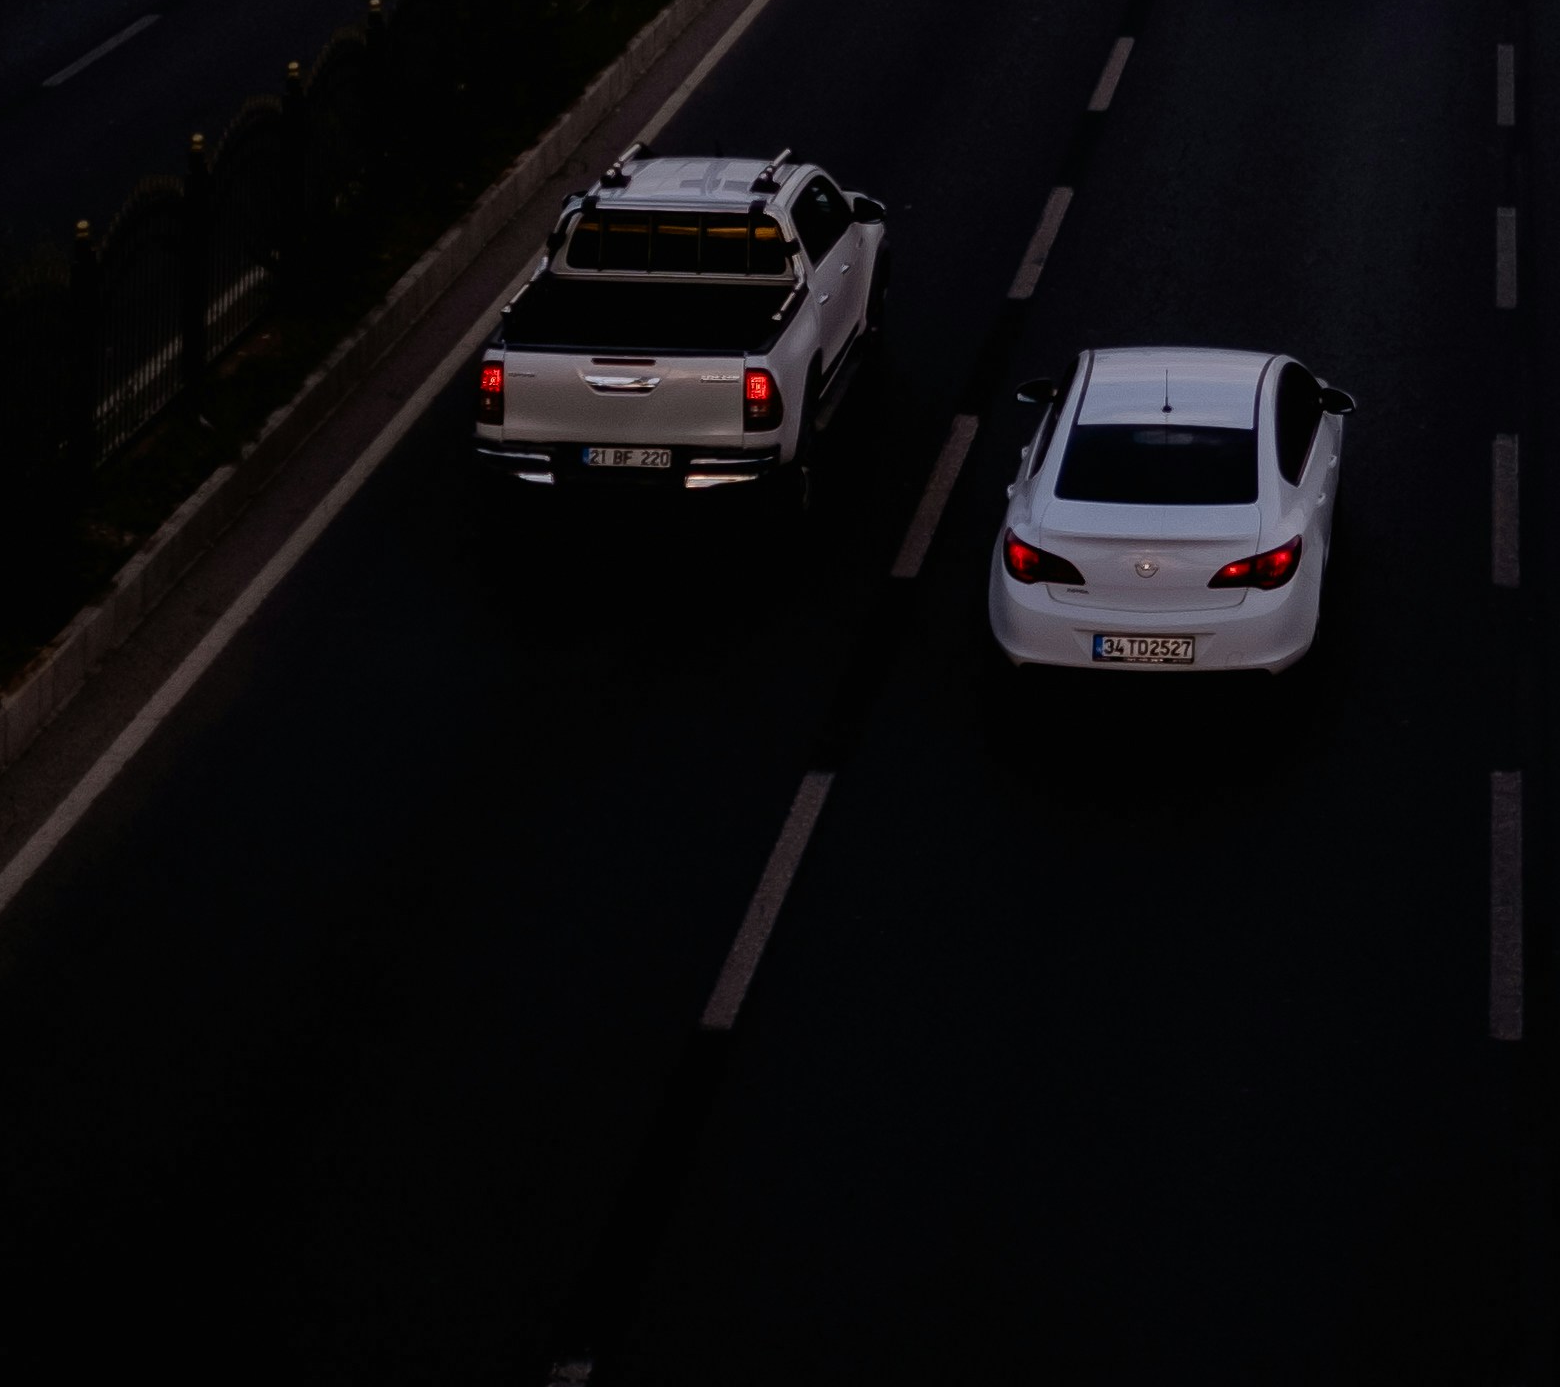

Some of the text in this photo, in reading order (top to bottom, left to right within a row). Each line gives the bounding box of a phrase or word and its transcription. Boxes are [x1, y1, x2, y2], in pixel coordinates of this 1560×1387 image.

[589, 449, 669, 466] 21 BF 220
